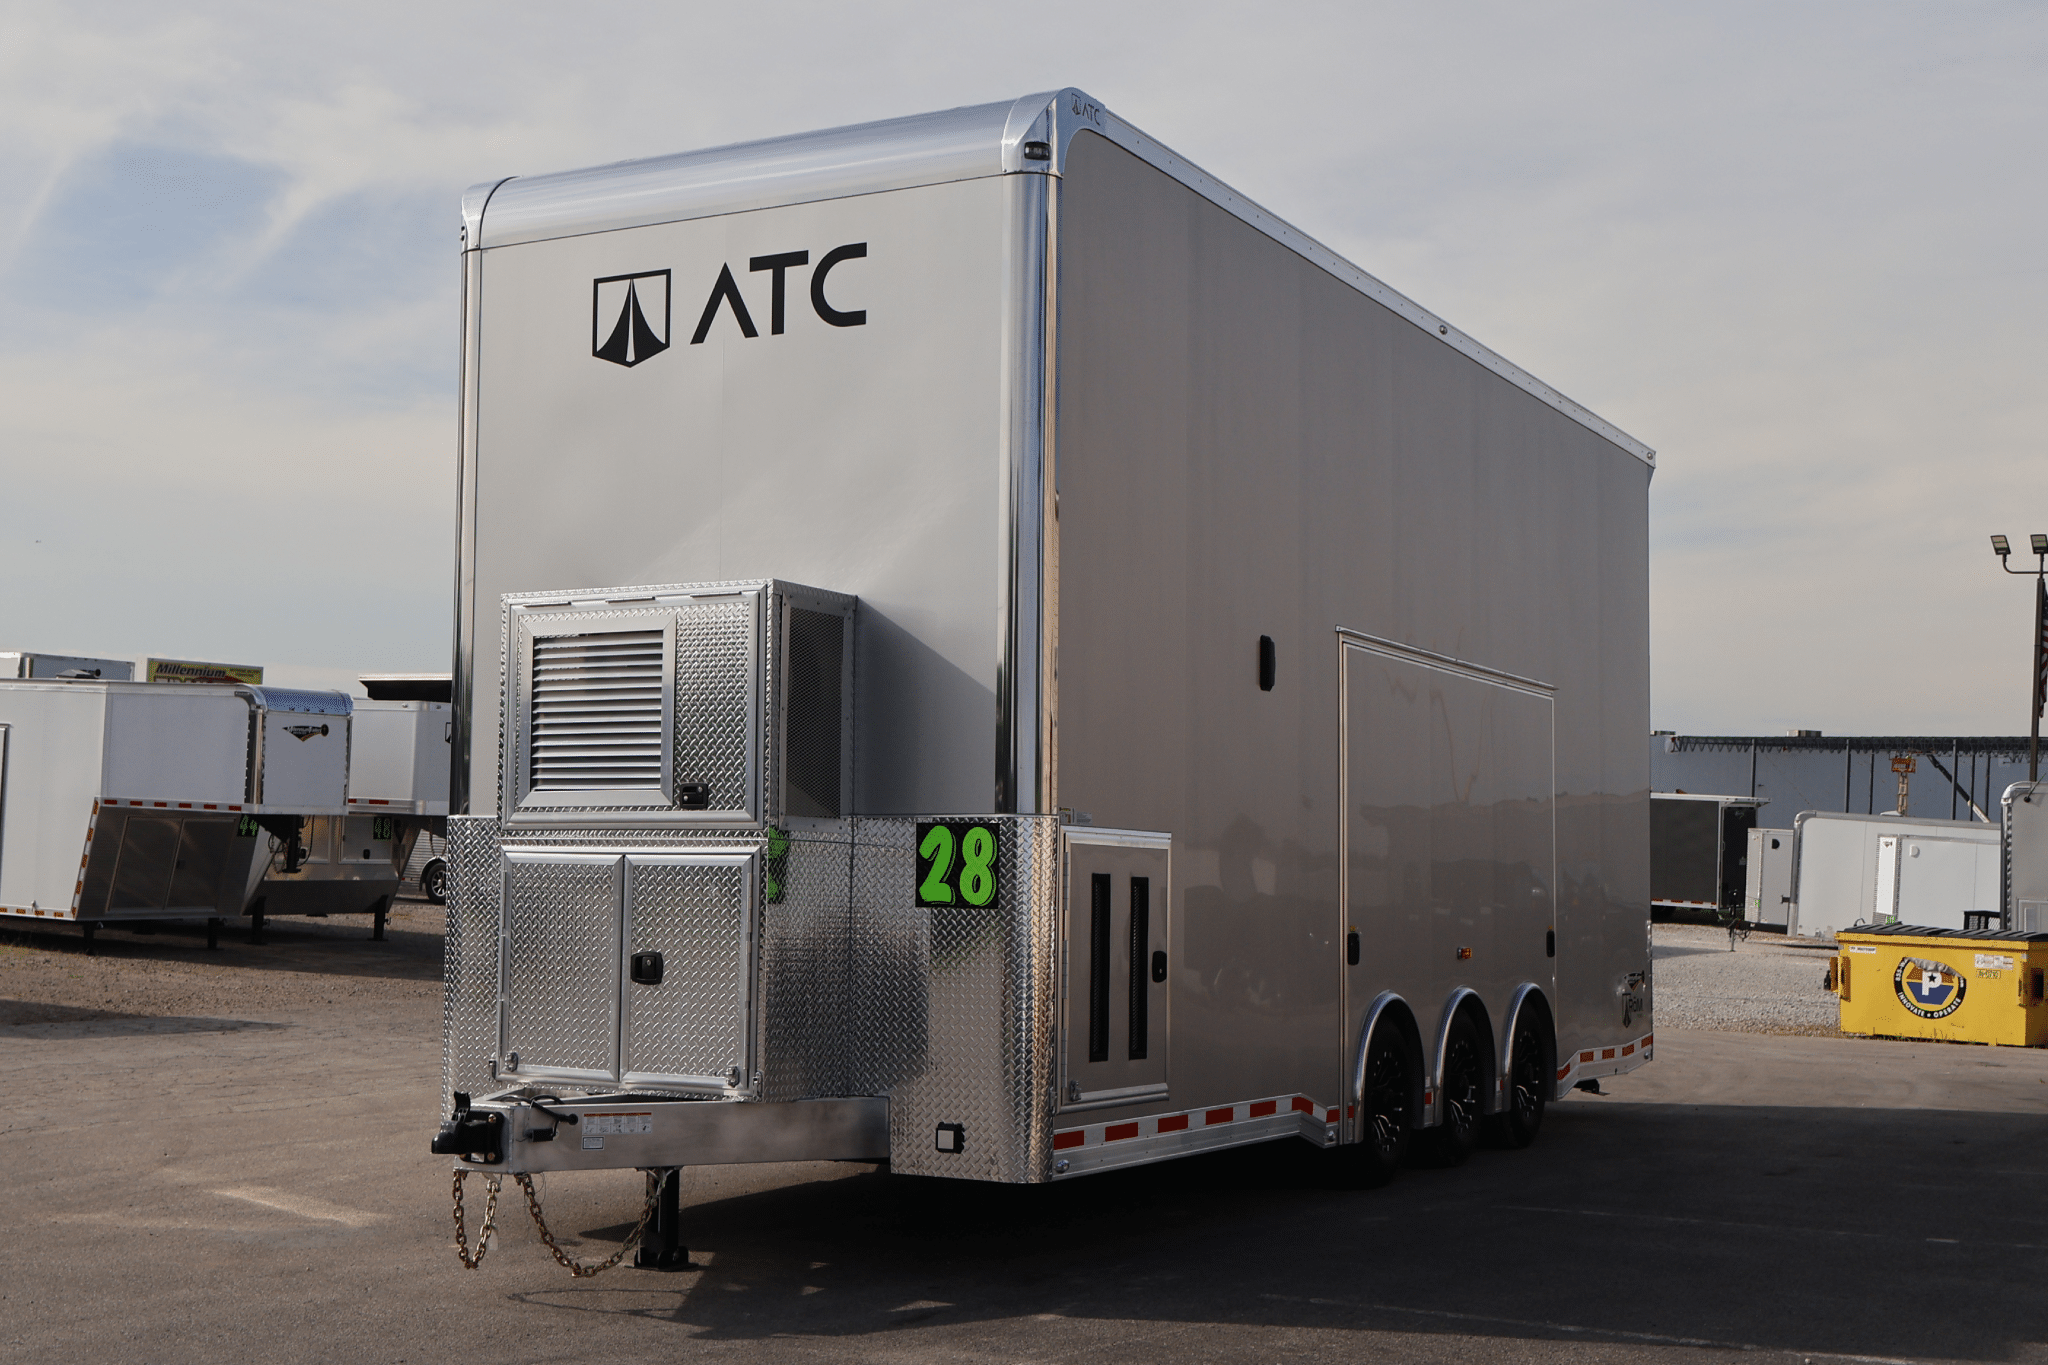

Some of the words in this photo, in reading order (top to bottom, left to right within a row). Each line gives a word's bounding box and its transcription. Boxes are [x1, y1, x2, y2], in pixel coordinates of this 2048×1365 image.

[1082, 102, 1101, 127] ATC
[690, 242, 867, 345] ATC
[156, 663, 226, 677] Millennium
[918, 825, 998, 906] 28
[1897, 991, 1926, 1017] INNOVATE
[1933, 997, 1961, 1018] OPERATE
